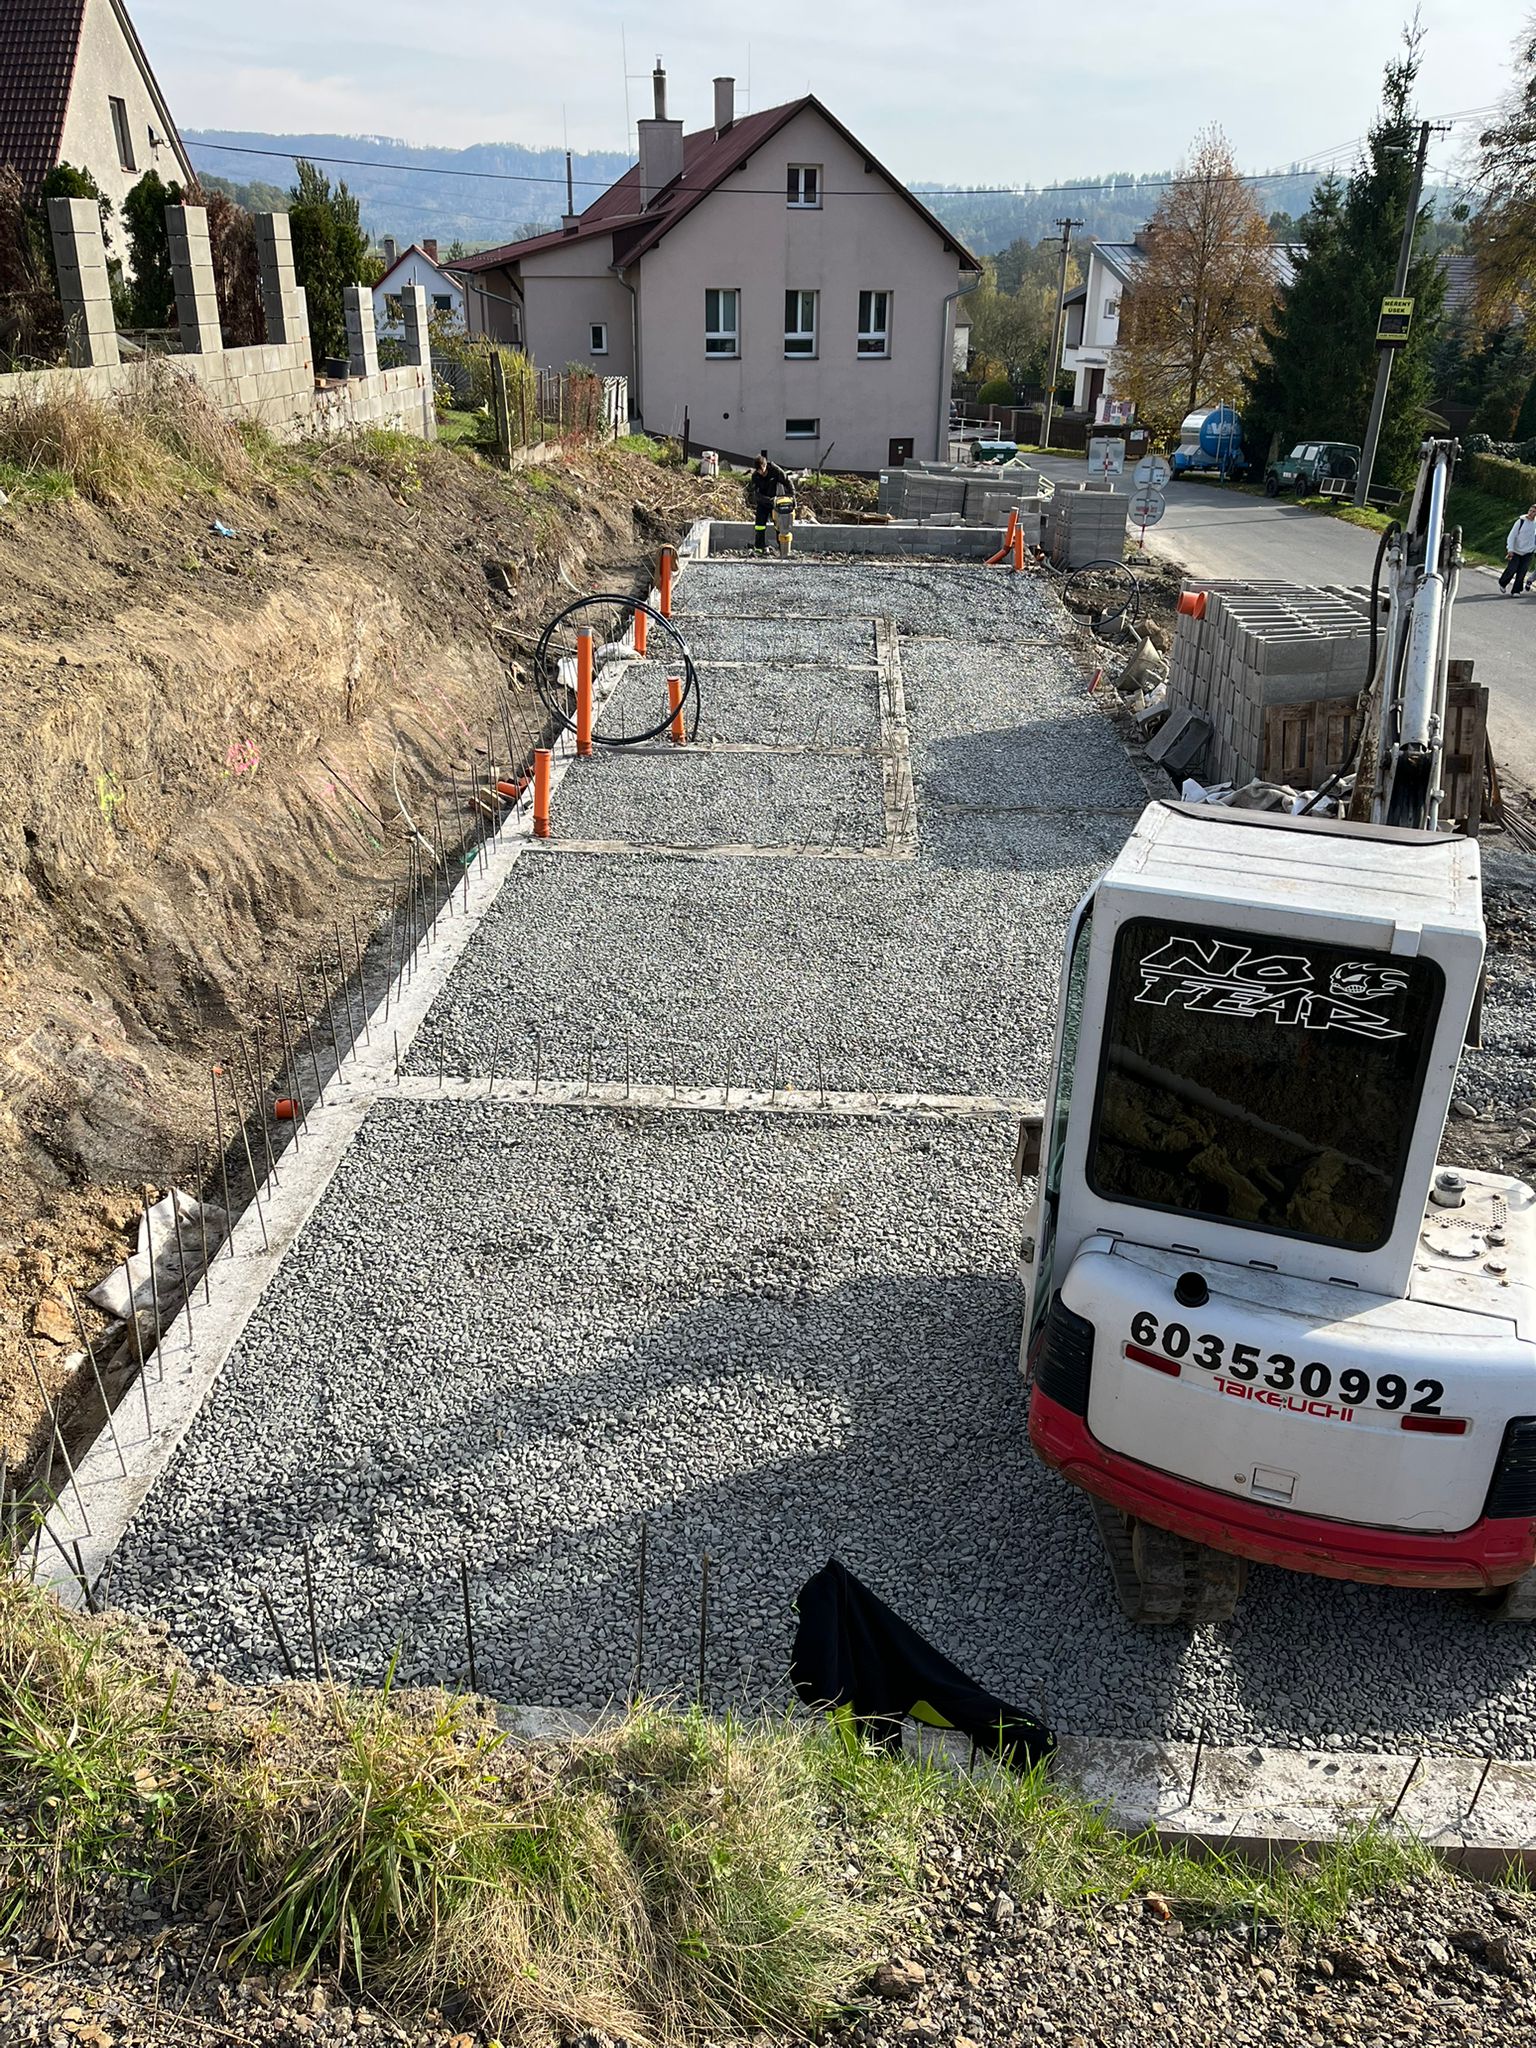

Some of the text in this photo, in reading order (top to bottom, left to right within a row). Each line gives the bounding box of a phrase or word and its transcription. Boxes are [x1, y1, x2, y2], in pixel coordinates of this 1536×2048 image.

[1139, 936, 1315, 984] NO
[1133, 968, 1408, 1039] FEAR
[1130, 1311, 1445, 1415] 603530992
[1213, 1376, 1354, 1422] TAKEUCHI
